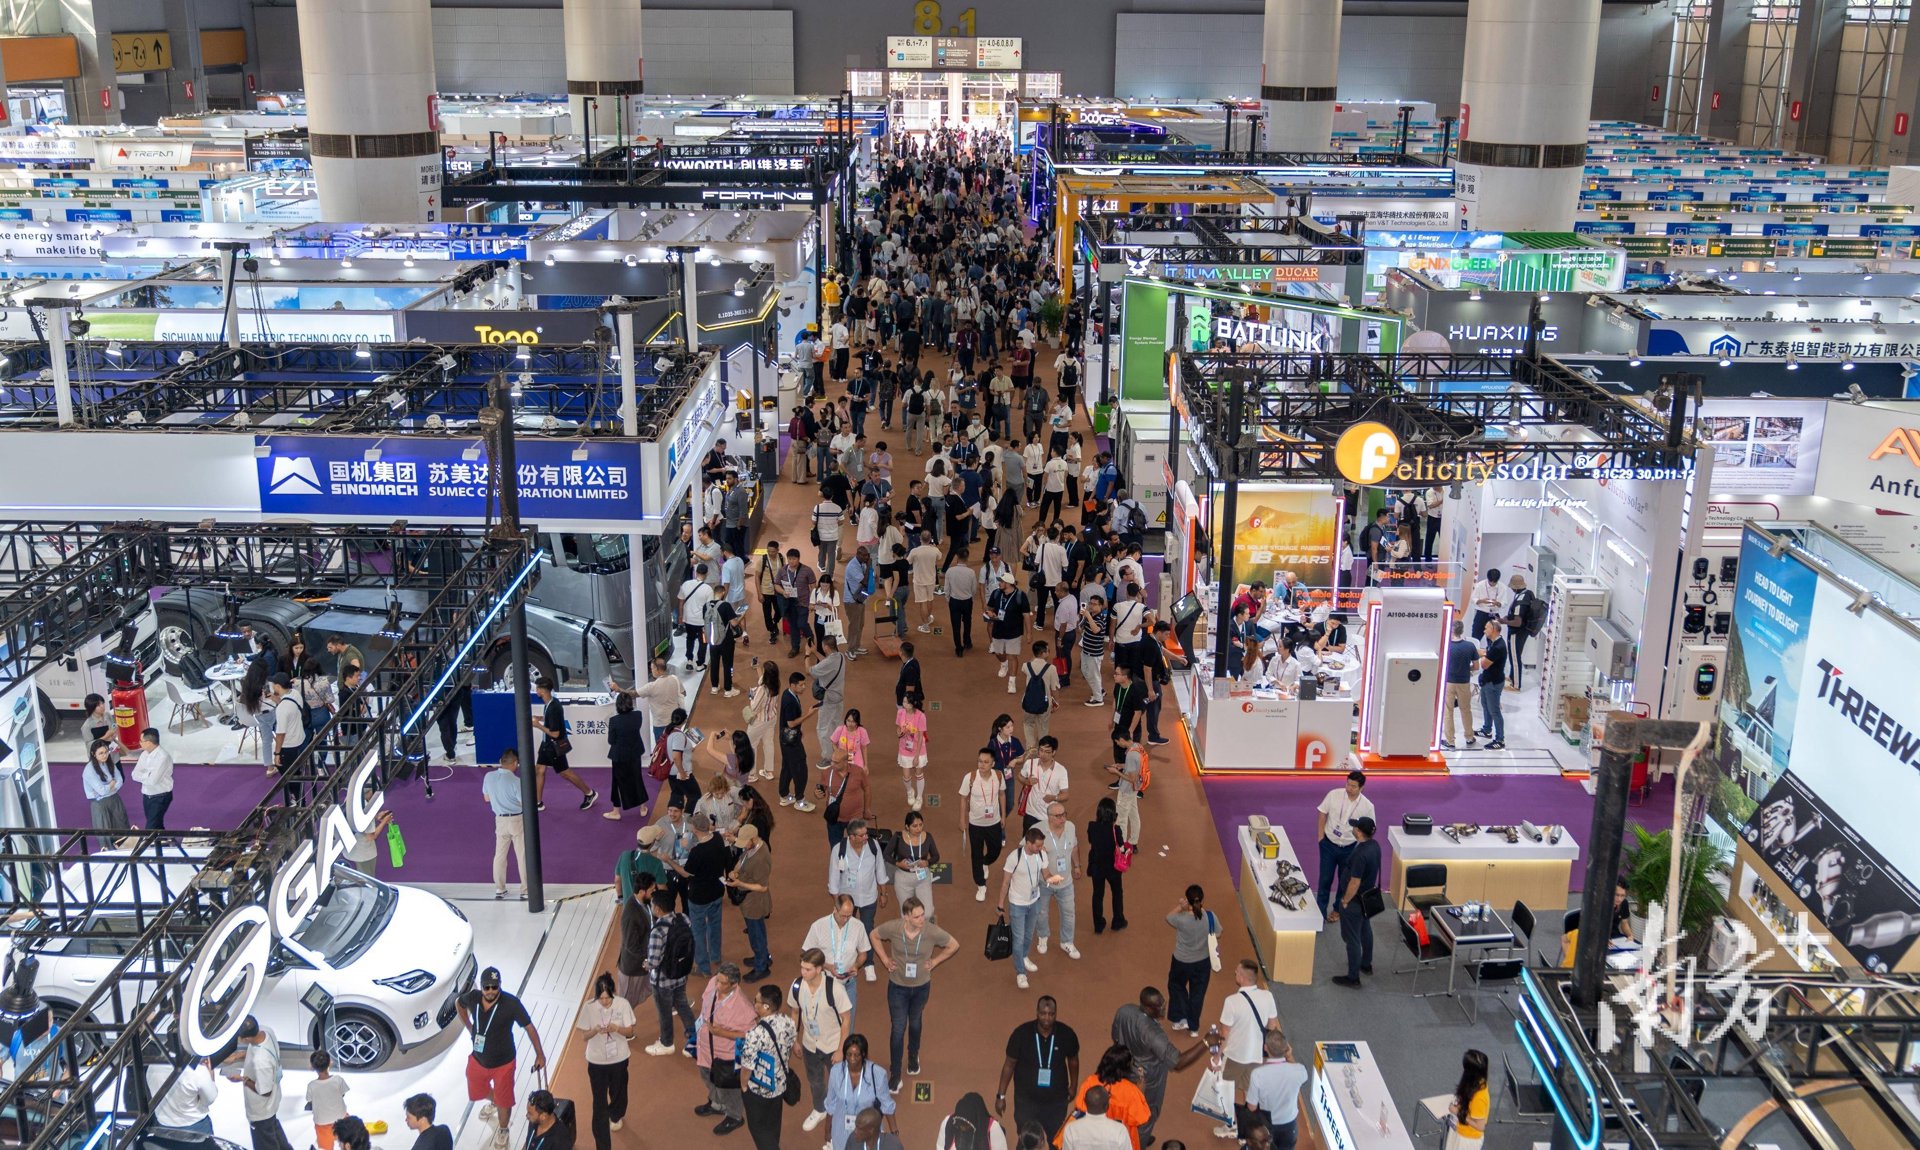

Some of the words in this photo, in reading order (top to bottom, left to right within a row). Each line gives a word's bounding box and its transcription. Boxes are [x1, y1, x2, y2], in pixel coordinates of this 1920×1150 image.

[914, 0, 976, 36] 8.1
[946, 39, 957, 47] 8.1
[702, 191, 813, 200] FORTHING
[14, 233, 53, 242] energy
[36, 246, 66, 255] make
[68, 245, 87, 255] life
[1275, 267, 1319, 277] DUCAR
[1217, 317, 1323, 354] BATTLINK
[329, 461, 417, 484] 国机集团
[428, 462, 628, 487] 苏美达份有限公司
[331, 483, 419, 496] SINOMACH
[429, 486, 474, 498] SUMEC
[574, 488, 629, 500] LIMITED
[1278, 555, 1330, 564] YEARS
[1754, 571, 1769, 591] HEAD
[1769, 581, 1777, 596] TO
[1776, 585, 1794, 607] LIGHT
[1744, 588, 1768, 613] JOURNEY
[1768, 604, 1776, 618] TO
[1775, 609, 1799, 635] DELIGHT
[1816, 658, 1920, 772] THREEW
[576, 720, 607, 729] 苏美达
[269, 749, 385, 939] GAC
